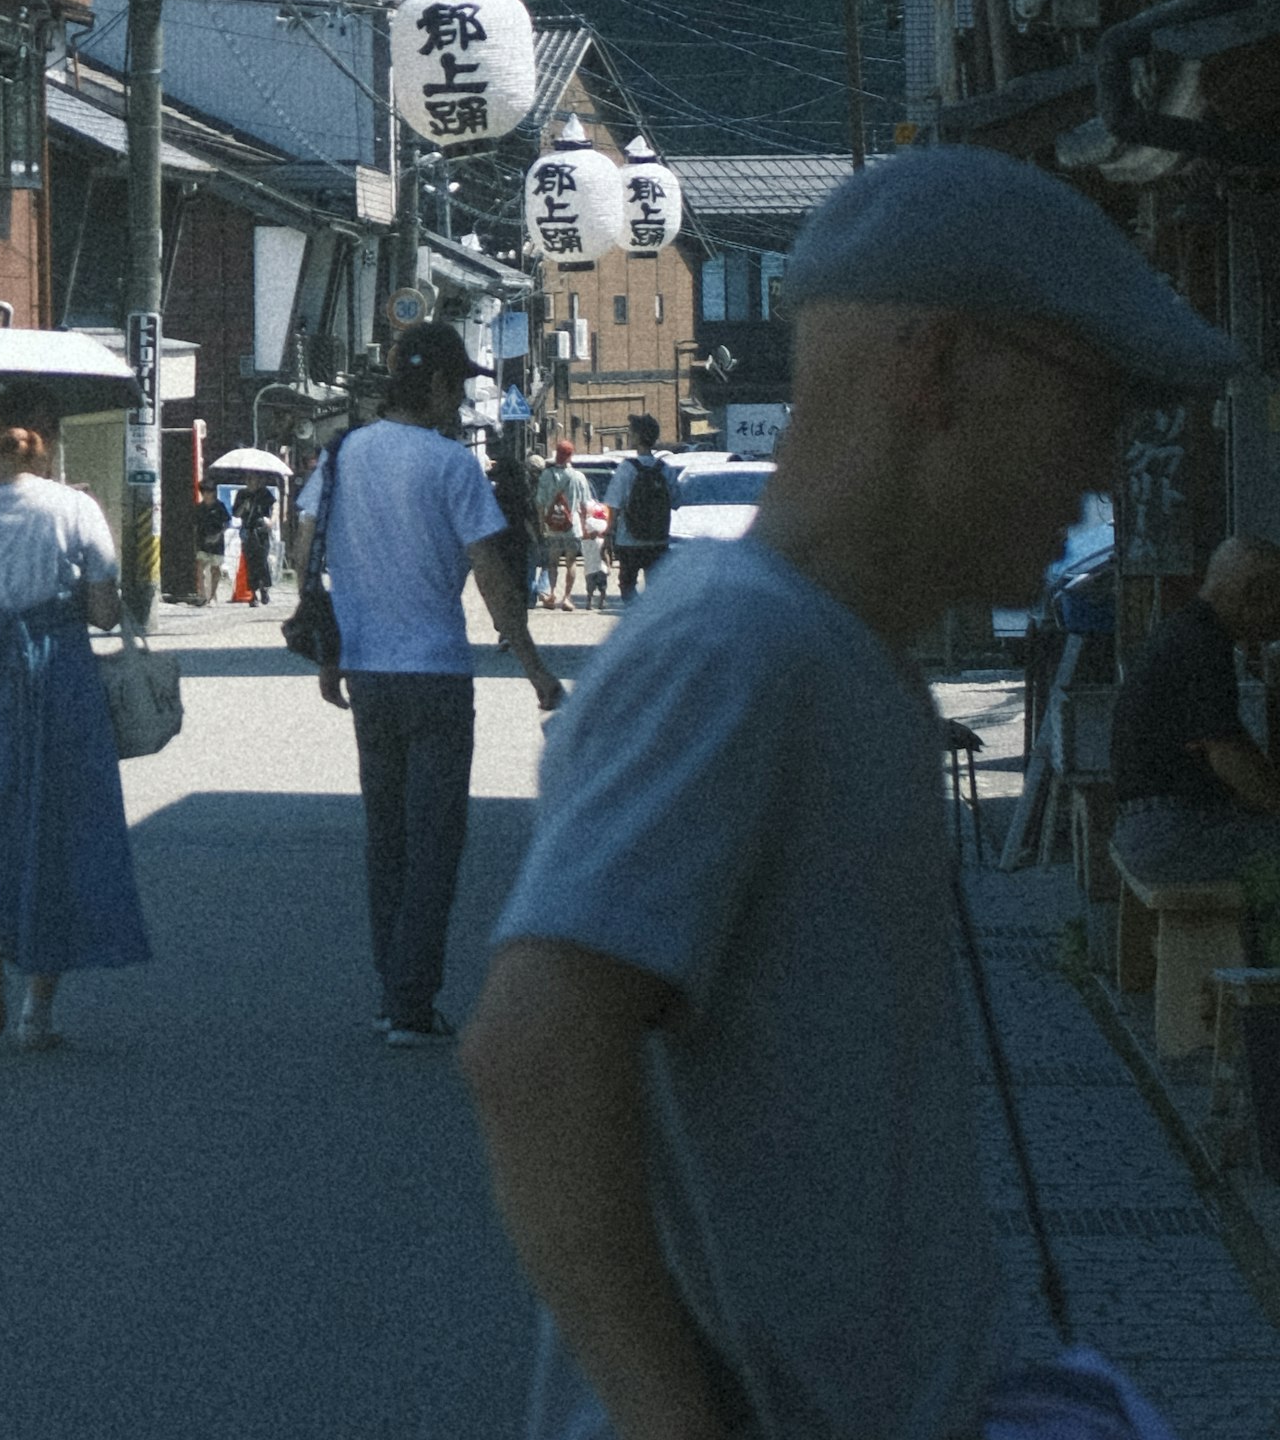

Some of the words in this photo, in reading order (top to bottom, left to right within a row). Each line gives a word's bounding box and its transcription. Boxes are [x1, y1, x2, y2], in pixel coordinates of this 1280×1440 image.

[415, 2, 490, 137] 郡上踊
[531, 162, 583, 254] 郡上踊
[625, 175, 667, 247] 郡上踊
[396, 300, 419, 318] 30
